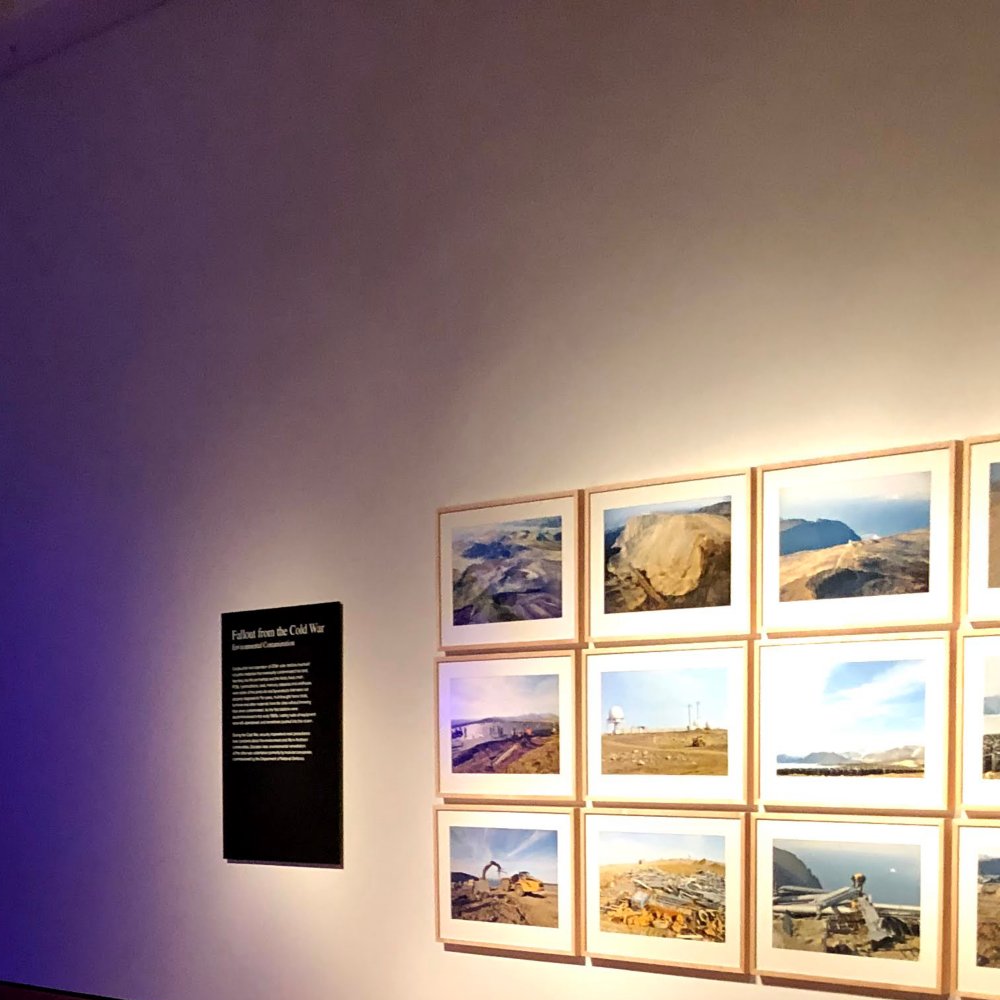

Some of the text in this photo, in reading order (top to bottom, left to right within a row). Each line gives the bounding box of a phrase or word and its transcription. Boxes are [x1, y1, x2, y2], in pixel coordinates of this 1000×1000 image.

[232, 623, 324, 640] Fallout from the Cold War
